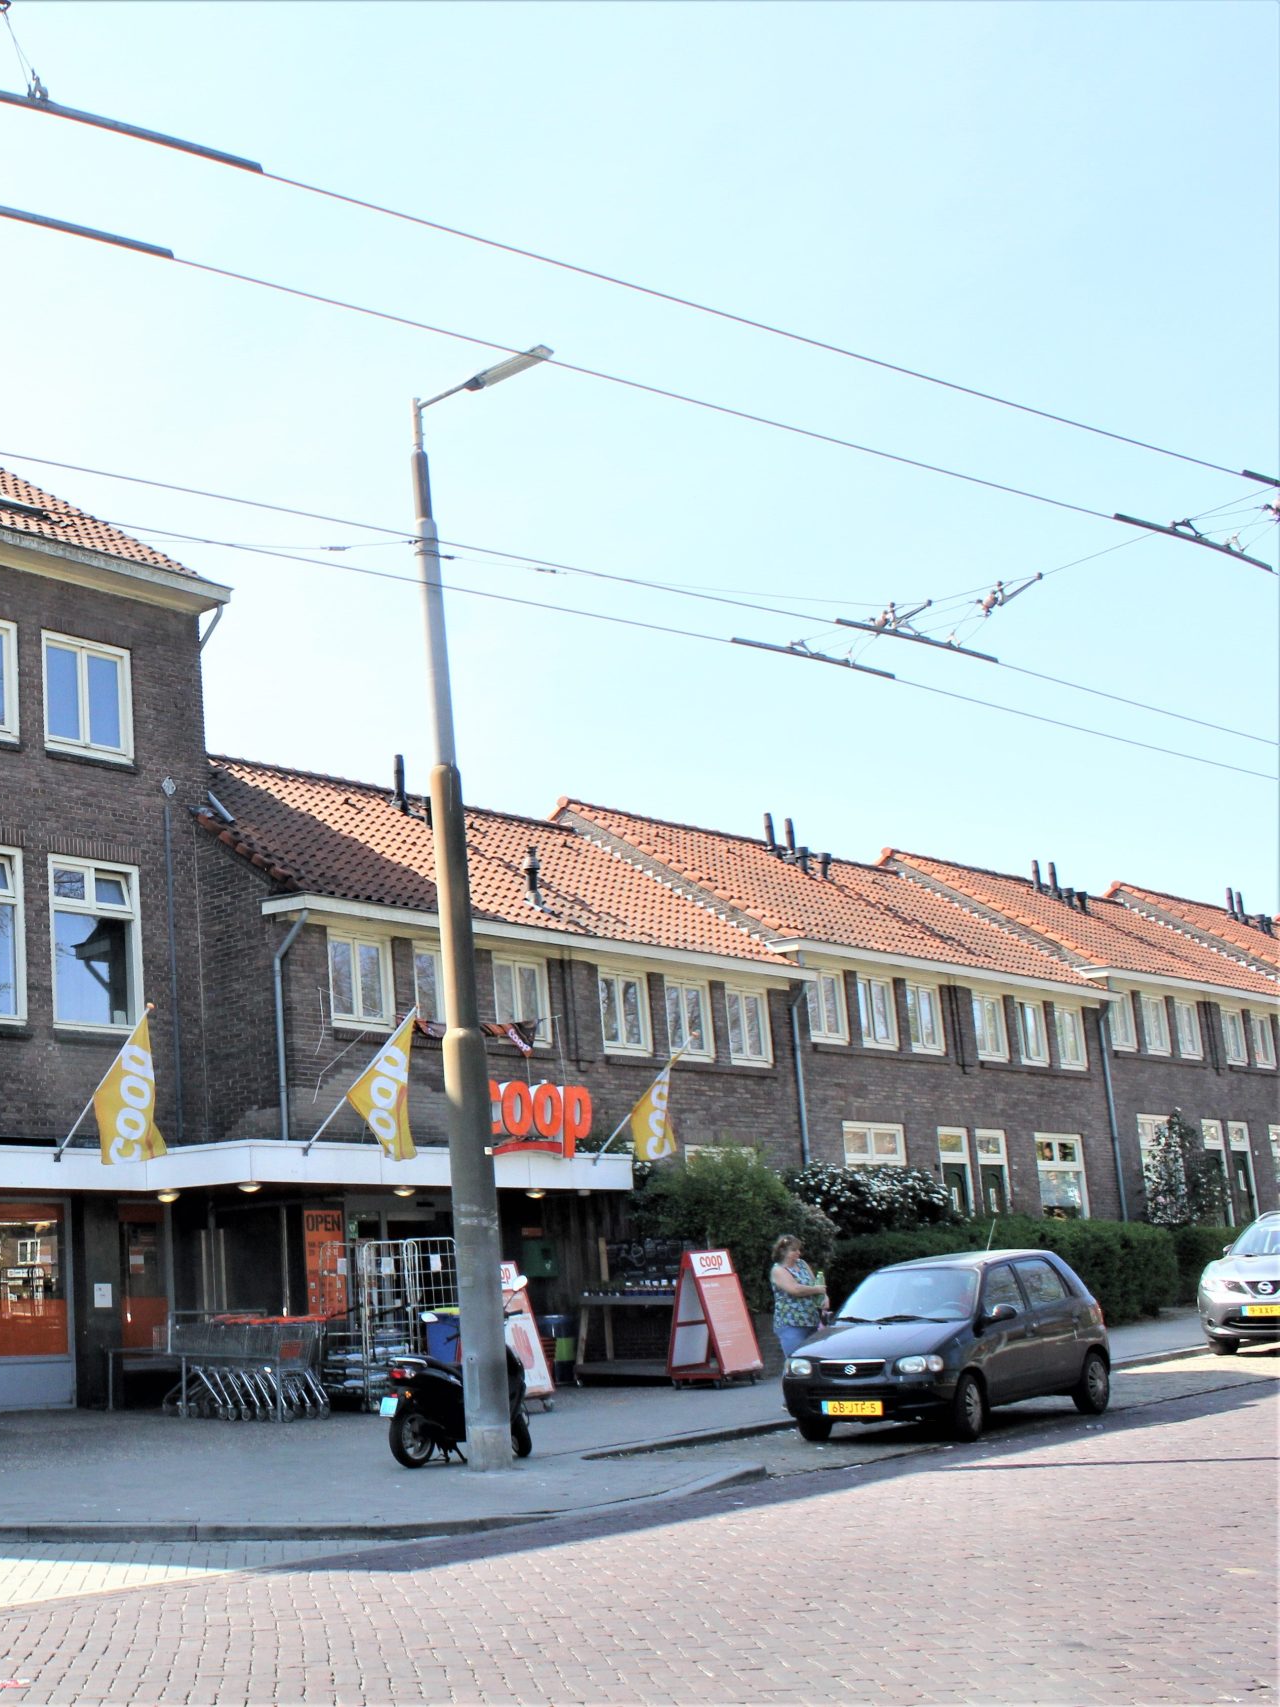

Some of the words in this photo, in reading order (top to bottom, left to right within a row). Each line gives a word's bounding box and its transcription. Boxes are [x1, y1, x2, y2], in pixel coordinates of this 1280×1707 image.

[109, 1044, 154, 1164] coop
[305, 1214, 342, 1232] OPEN
[700, 1255, 723, 1271] coop
